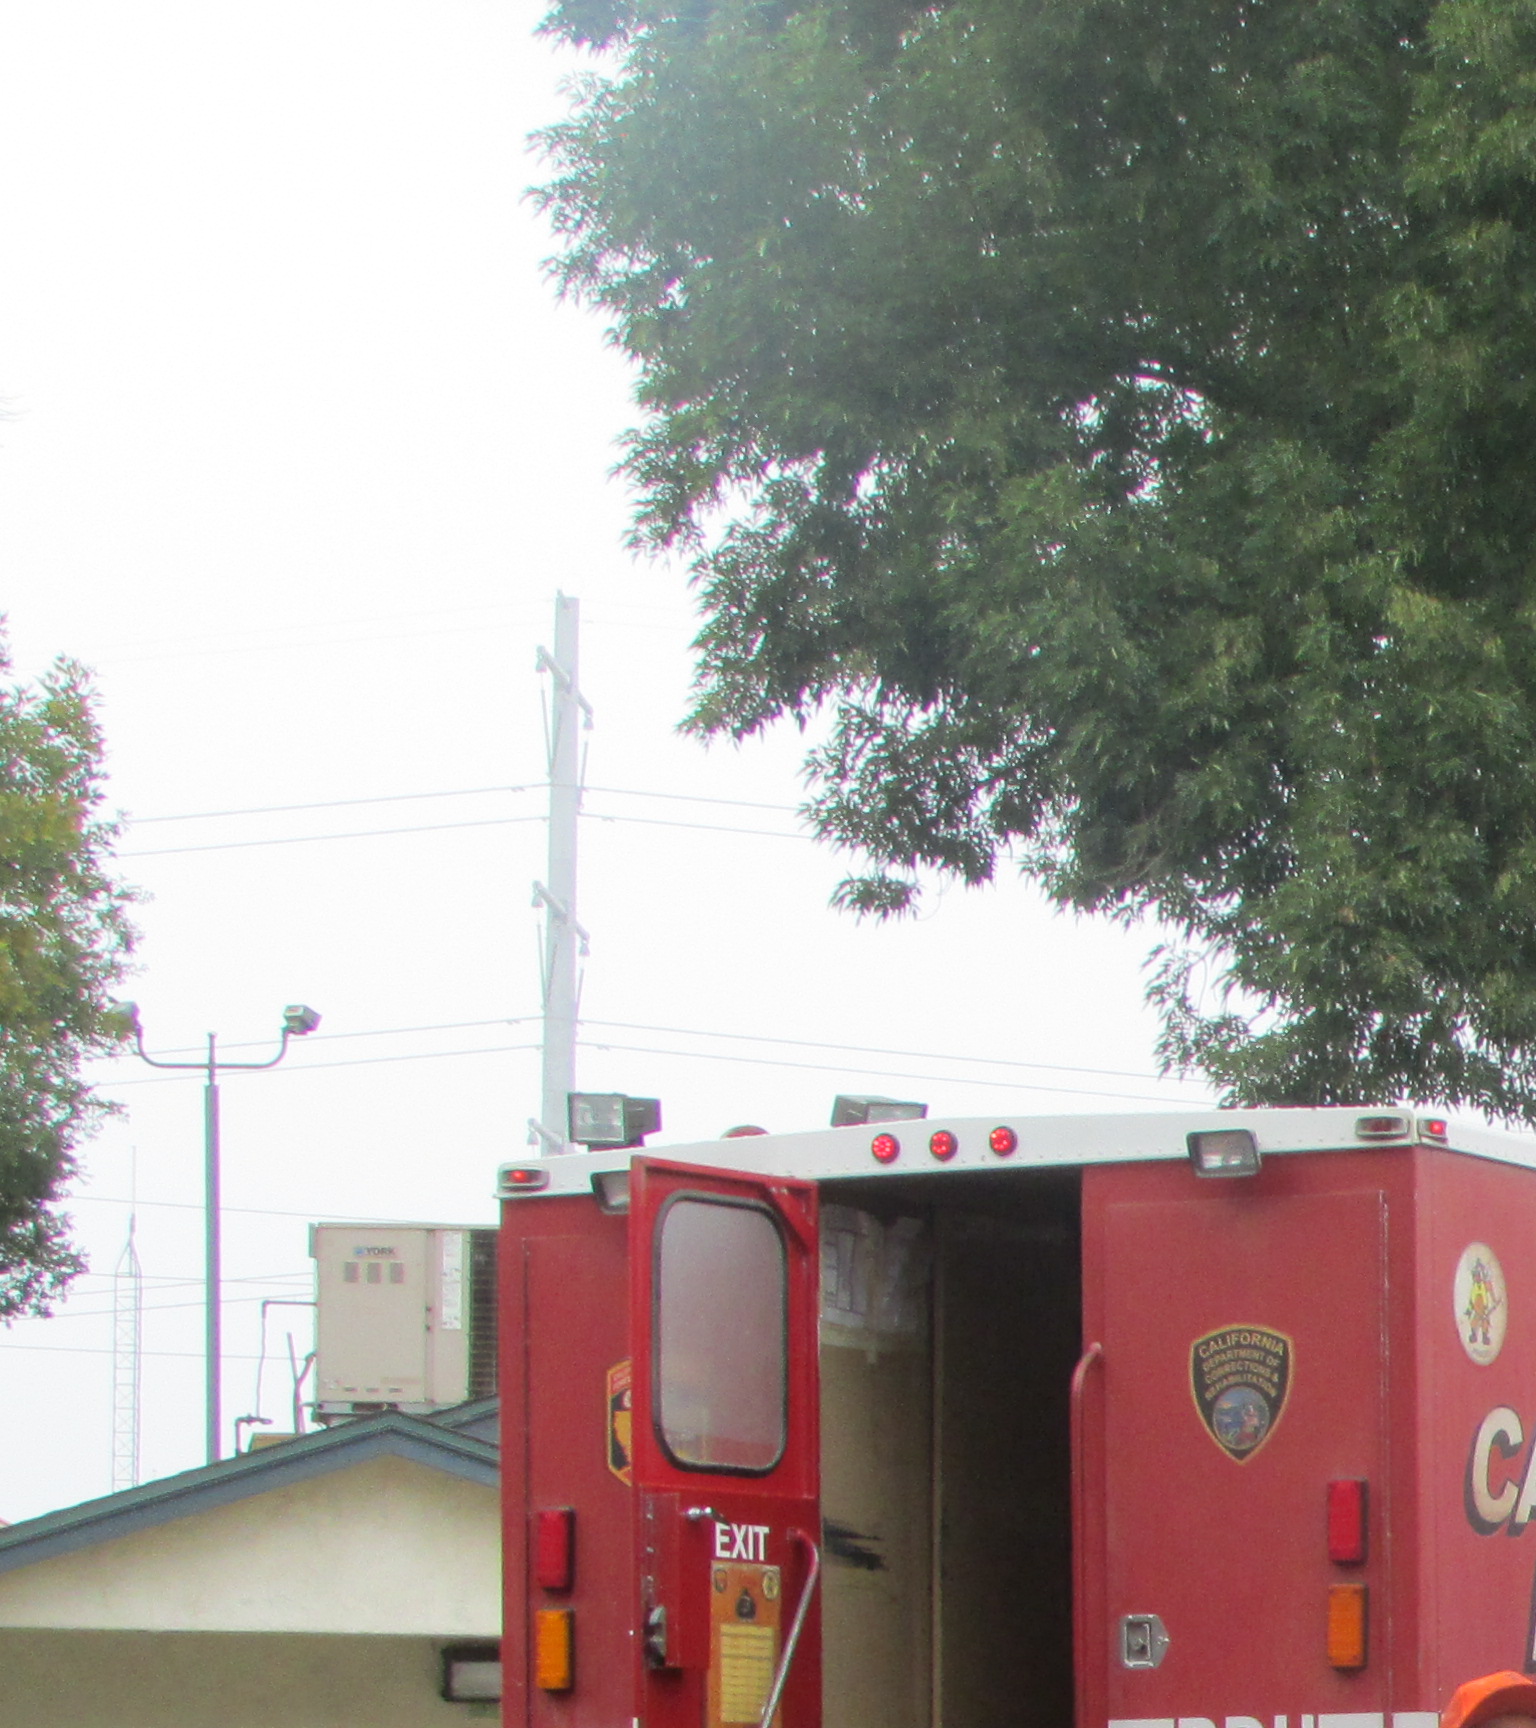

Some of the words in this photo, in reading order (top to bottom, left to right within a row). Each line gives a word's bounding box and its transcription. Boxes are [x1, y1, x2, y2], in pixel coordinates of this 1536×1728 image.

[1199, 1332, 1284, 1358] CALIFORNIA
[1203, 1348, 1264, 1372] DEPARTMENT
[715, 1521, 770, 1561] EXIT
